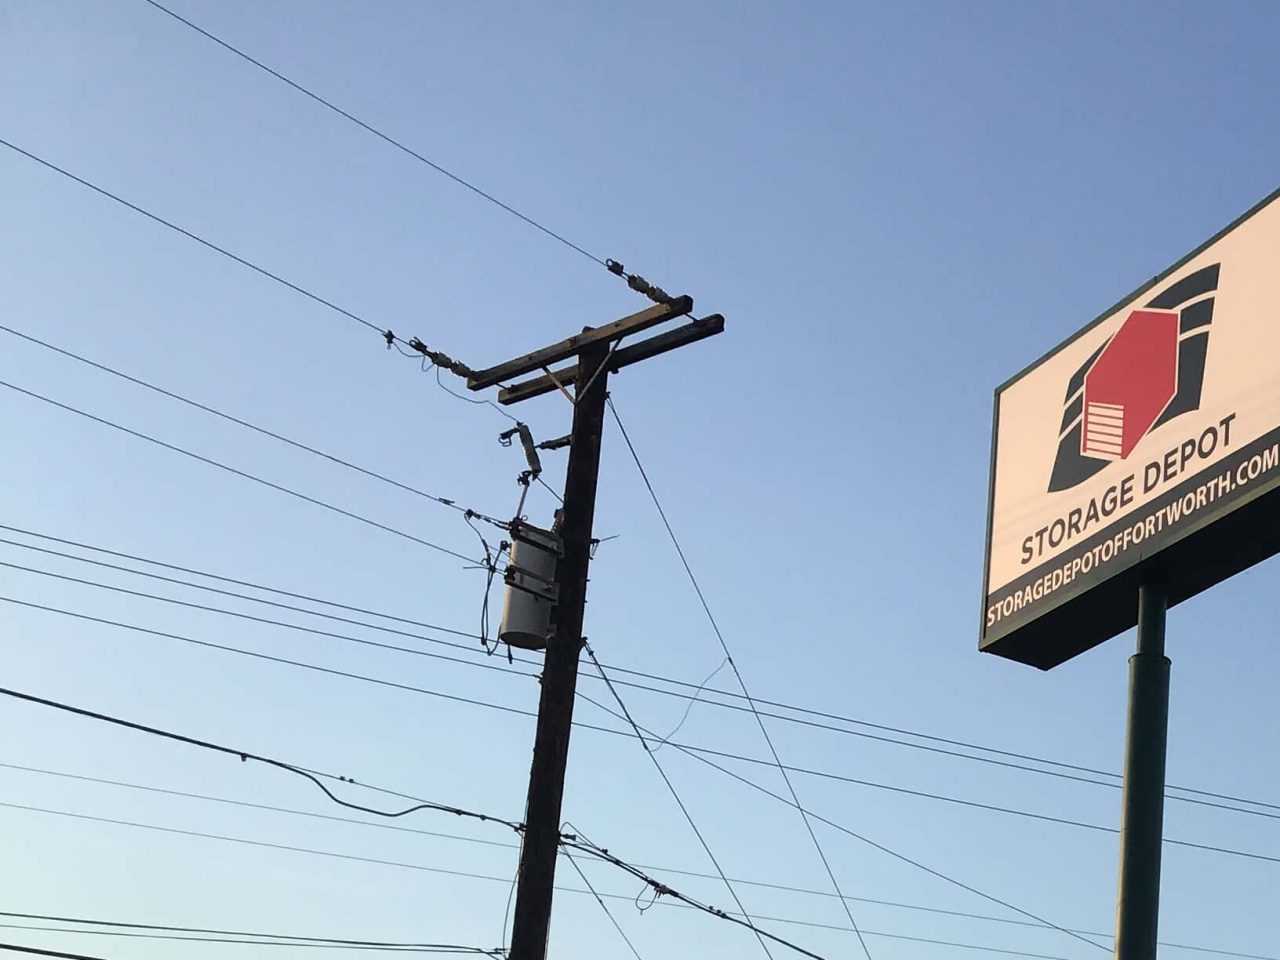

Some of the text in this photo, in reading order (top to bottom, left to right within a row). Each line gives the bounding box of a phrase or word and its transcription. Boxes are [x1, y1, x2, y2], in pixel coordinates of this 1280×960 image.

[986, 443, 1280, 628] STORAGEDEPOTOFFORTWORTH.COM
[1020, 412, 1236, 566] STORAGE DEPOT
